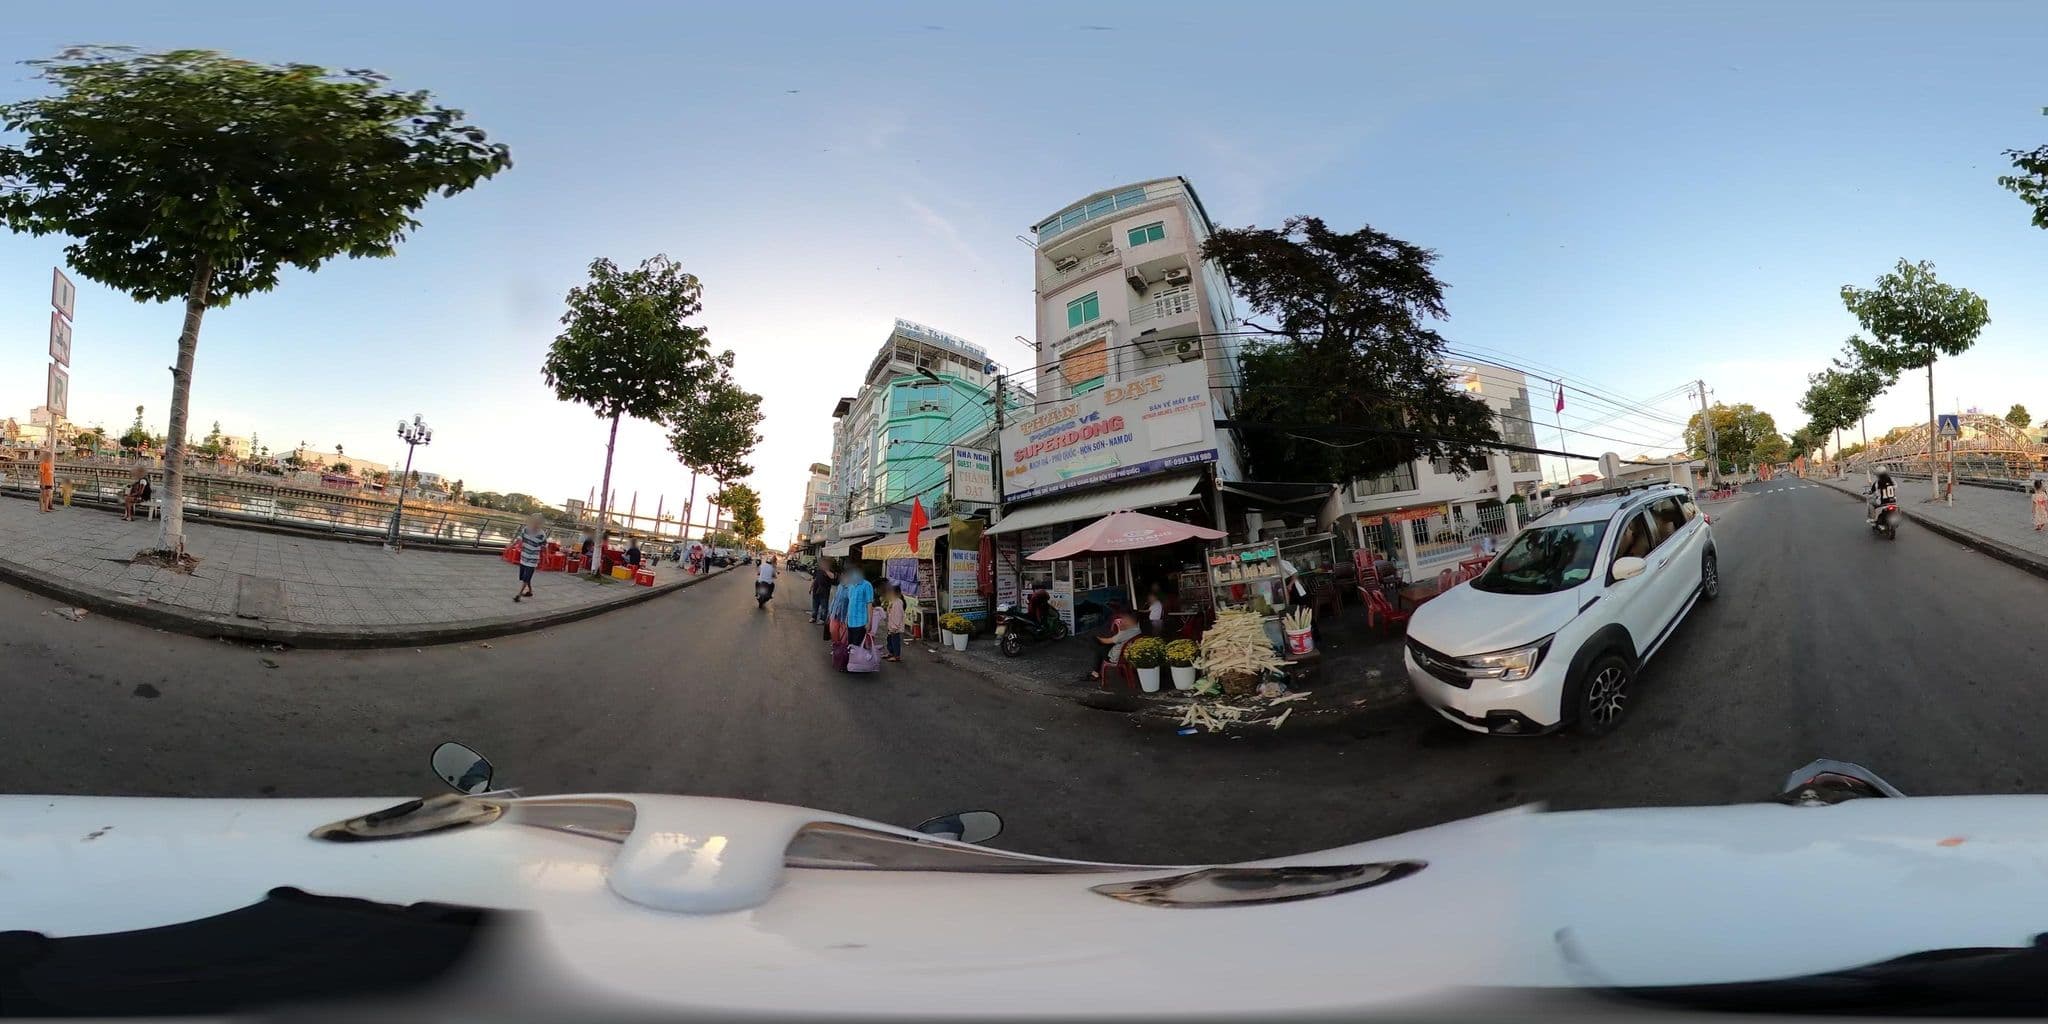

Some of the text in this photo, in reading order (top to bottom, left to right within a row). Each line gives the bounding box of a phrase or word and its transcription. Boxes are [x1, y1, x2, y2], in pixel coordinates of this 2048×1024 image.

[1187, 394, 1200, 402] BAY
[1014, 415, 1125, 463] SUPERDONG
[1882, 486, 1894, 498] 10
